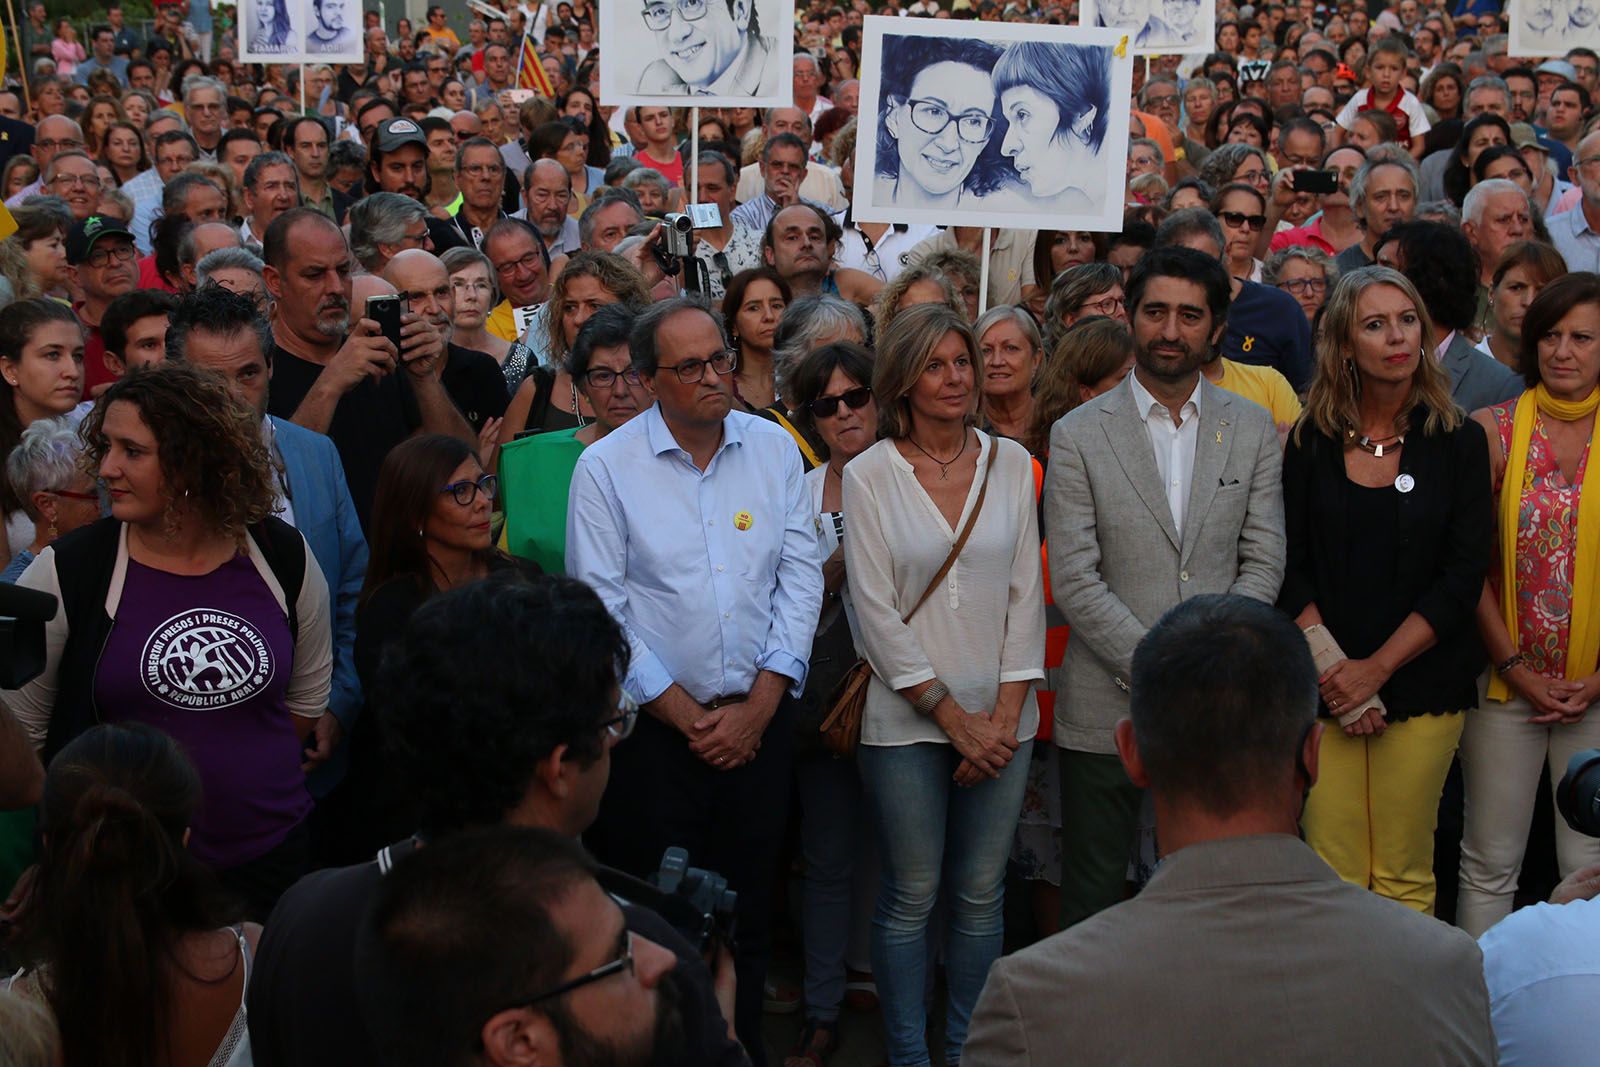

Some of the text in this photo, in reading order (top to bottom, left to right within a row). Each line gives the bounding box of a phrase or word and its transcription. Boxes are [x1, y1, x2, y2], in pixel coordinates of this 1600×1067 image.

[148, 639, 165, 686] LLIBERTAT
[160, 617, 194, 641] PRESOS
[195, 615, 200, 625] I
[202, 614, 240, 630] PRESES
[168, 683, 256, 706] REPÚBLICA ARA!
